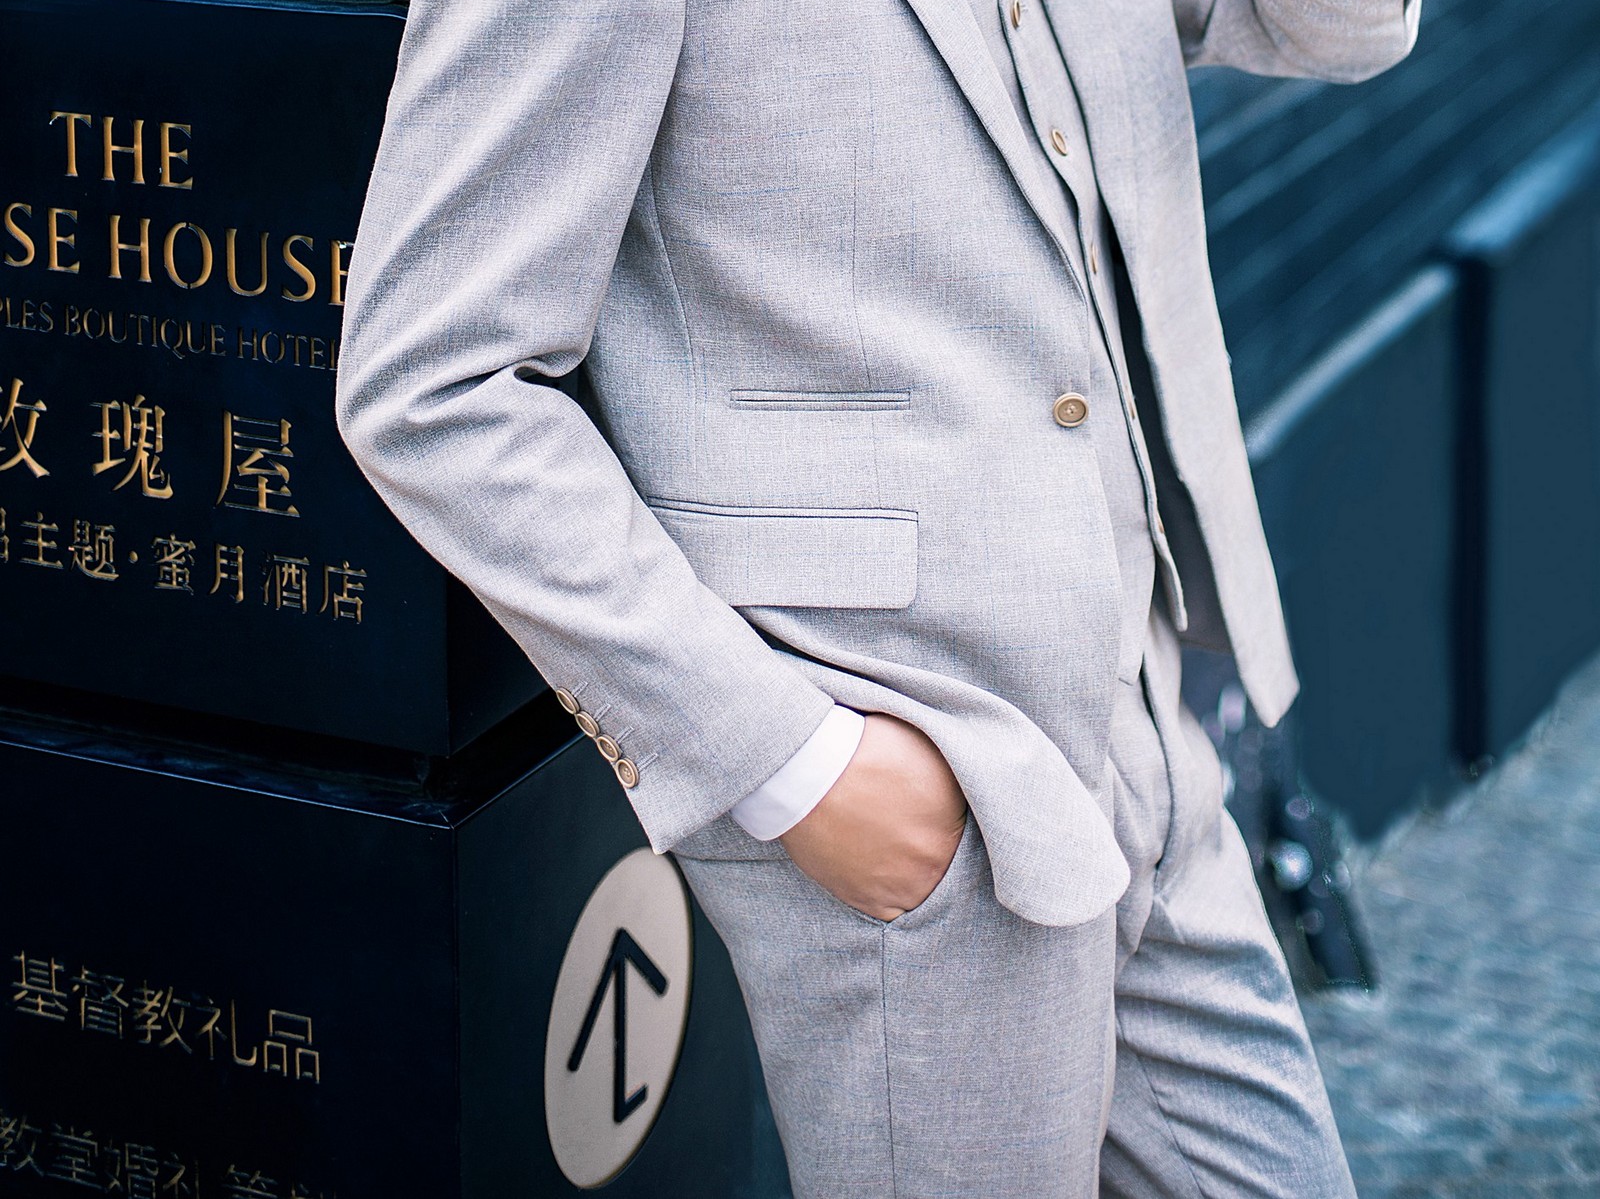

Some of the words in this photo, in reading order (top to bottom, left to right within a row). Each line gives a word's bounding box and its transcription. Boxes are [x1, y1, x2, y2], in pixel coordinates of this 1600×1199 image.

[49, 110, 194, 190] THE
[107, 213, 355, 307] HOUSE
[0, 295, 54, 333] LES
[64, 304, 228, 360] BOUTIQUE
[0, 506, 368, 624] 主题·蜜月酒店
[10, 949, 321, 1085] 基督教礼品
